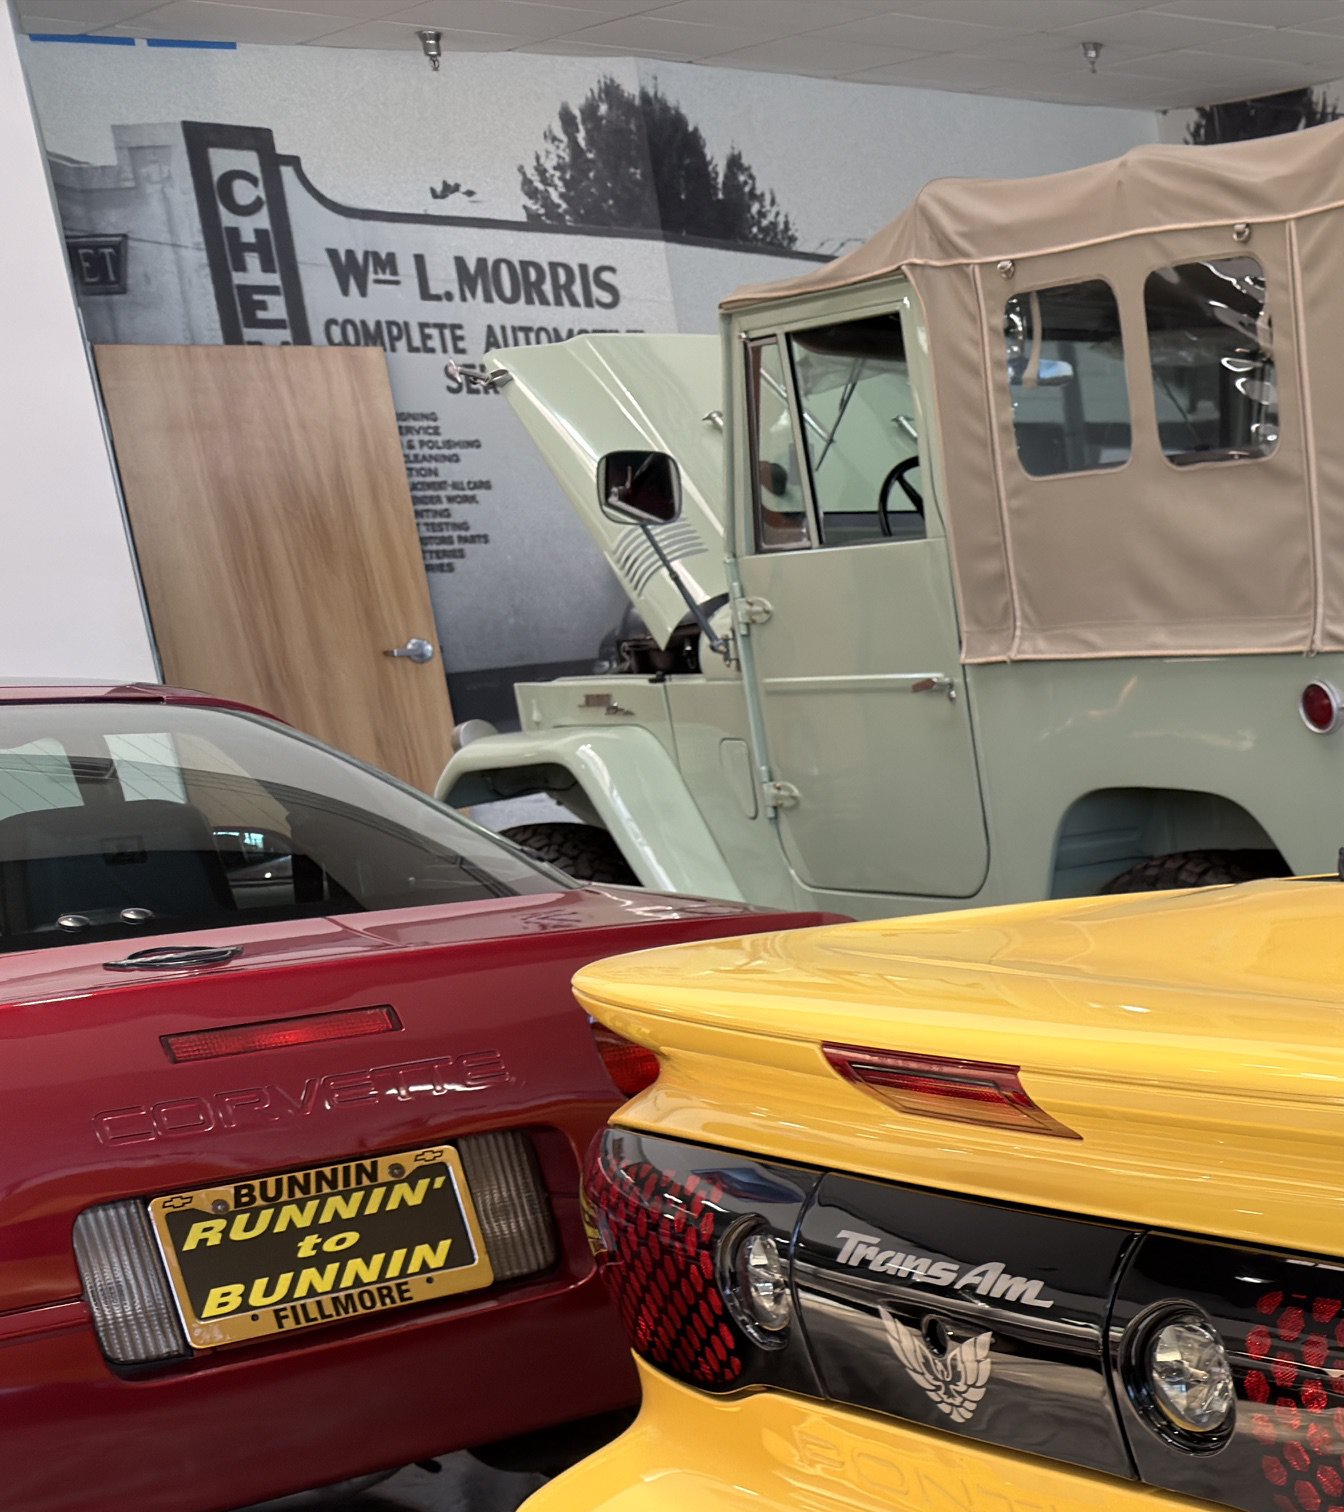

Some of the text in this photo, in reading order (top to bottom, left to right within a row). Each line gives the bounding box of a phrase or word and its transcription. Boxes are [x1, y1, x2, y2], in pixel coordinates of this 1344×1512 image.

[216, 169, 288, 345] CHE
[324, 318, 467, 355] COMPLETE
[91, 1048, 513, 1147] CORVETTE
[182, 1175, 447, 1252] RUNNIN'
[233, 1160, 379, 1209] BUNNIN
[200, 1238, 453, 1319] BUNNIN
[296, 1230, 360, 1258] to
[836, 1229, 1055, 1308] Trans Am
[273, 1281, 414, 1330] FILLMORE
